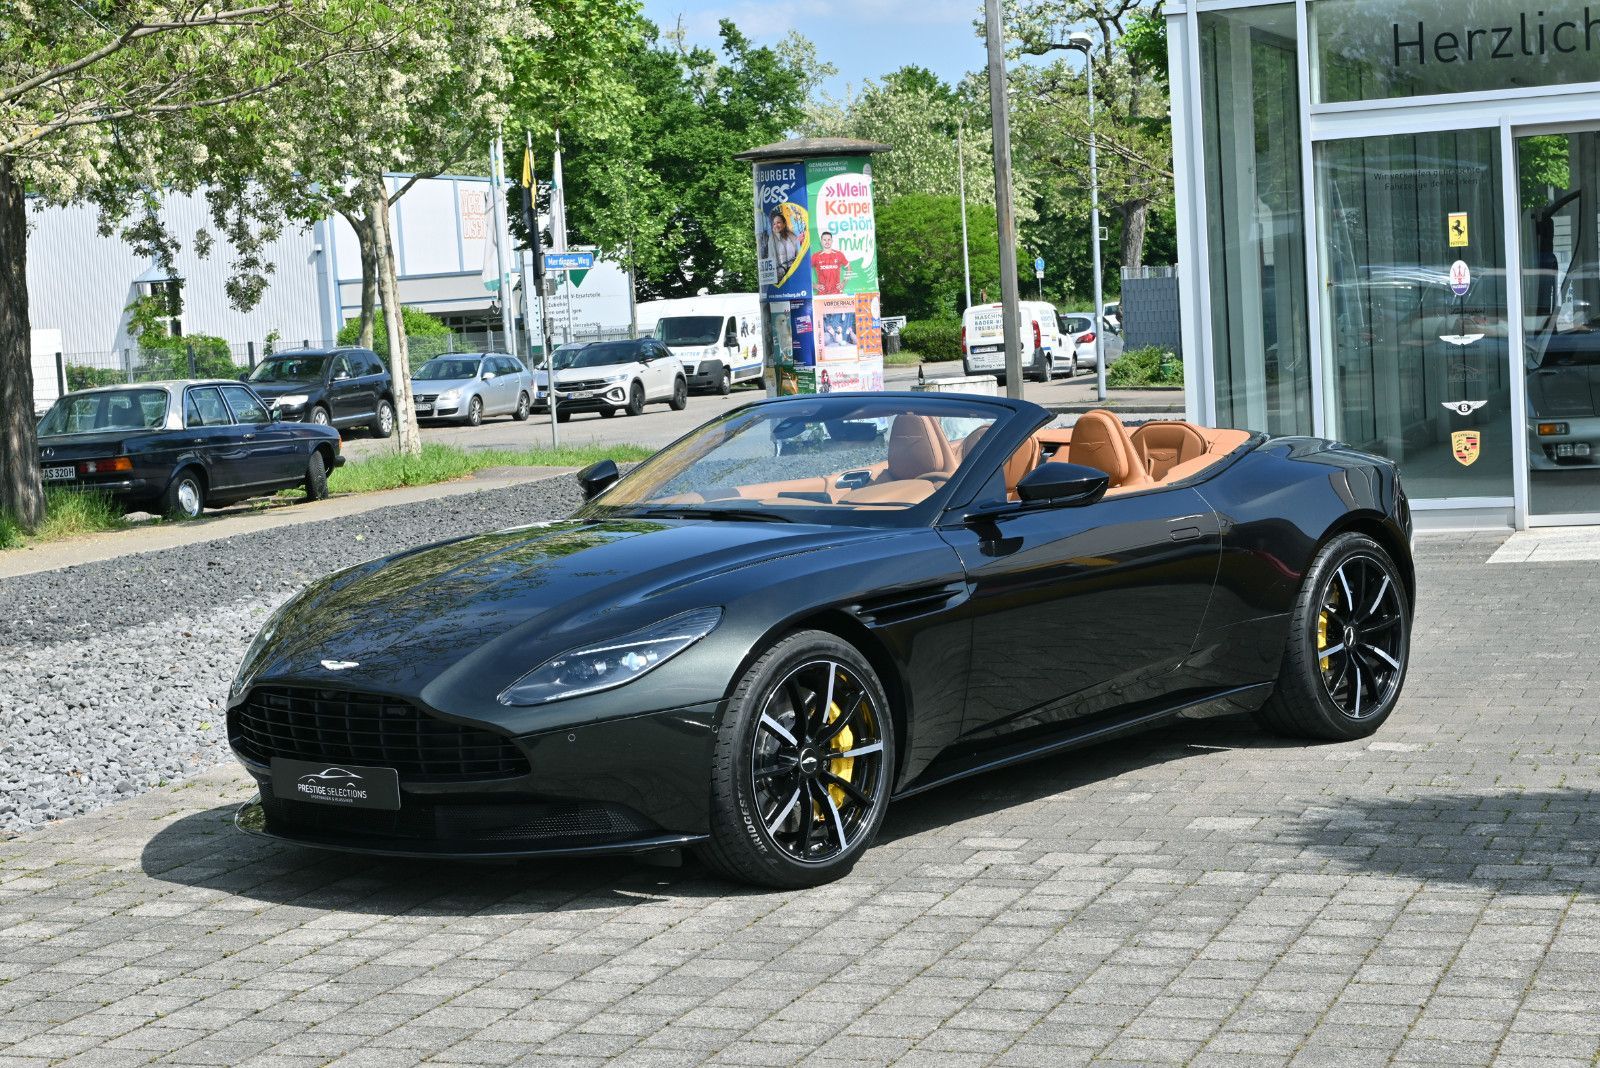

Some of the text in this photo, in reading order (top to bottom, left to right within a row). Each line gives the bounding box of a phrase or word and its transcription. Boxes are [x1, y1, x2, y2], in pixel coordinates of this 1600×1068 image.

[1393, 6, 1600, 67] Herzlich
[824, 200, 871, 218] Körper
[577, 256, 590, 266] Weg
[55, 466, 75, 478] 320H
[297, 783, 368, 799] PRESTIGE SELECTIONS
